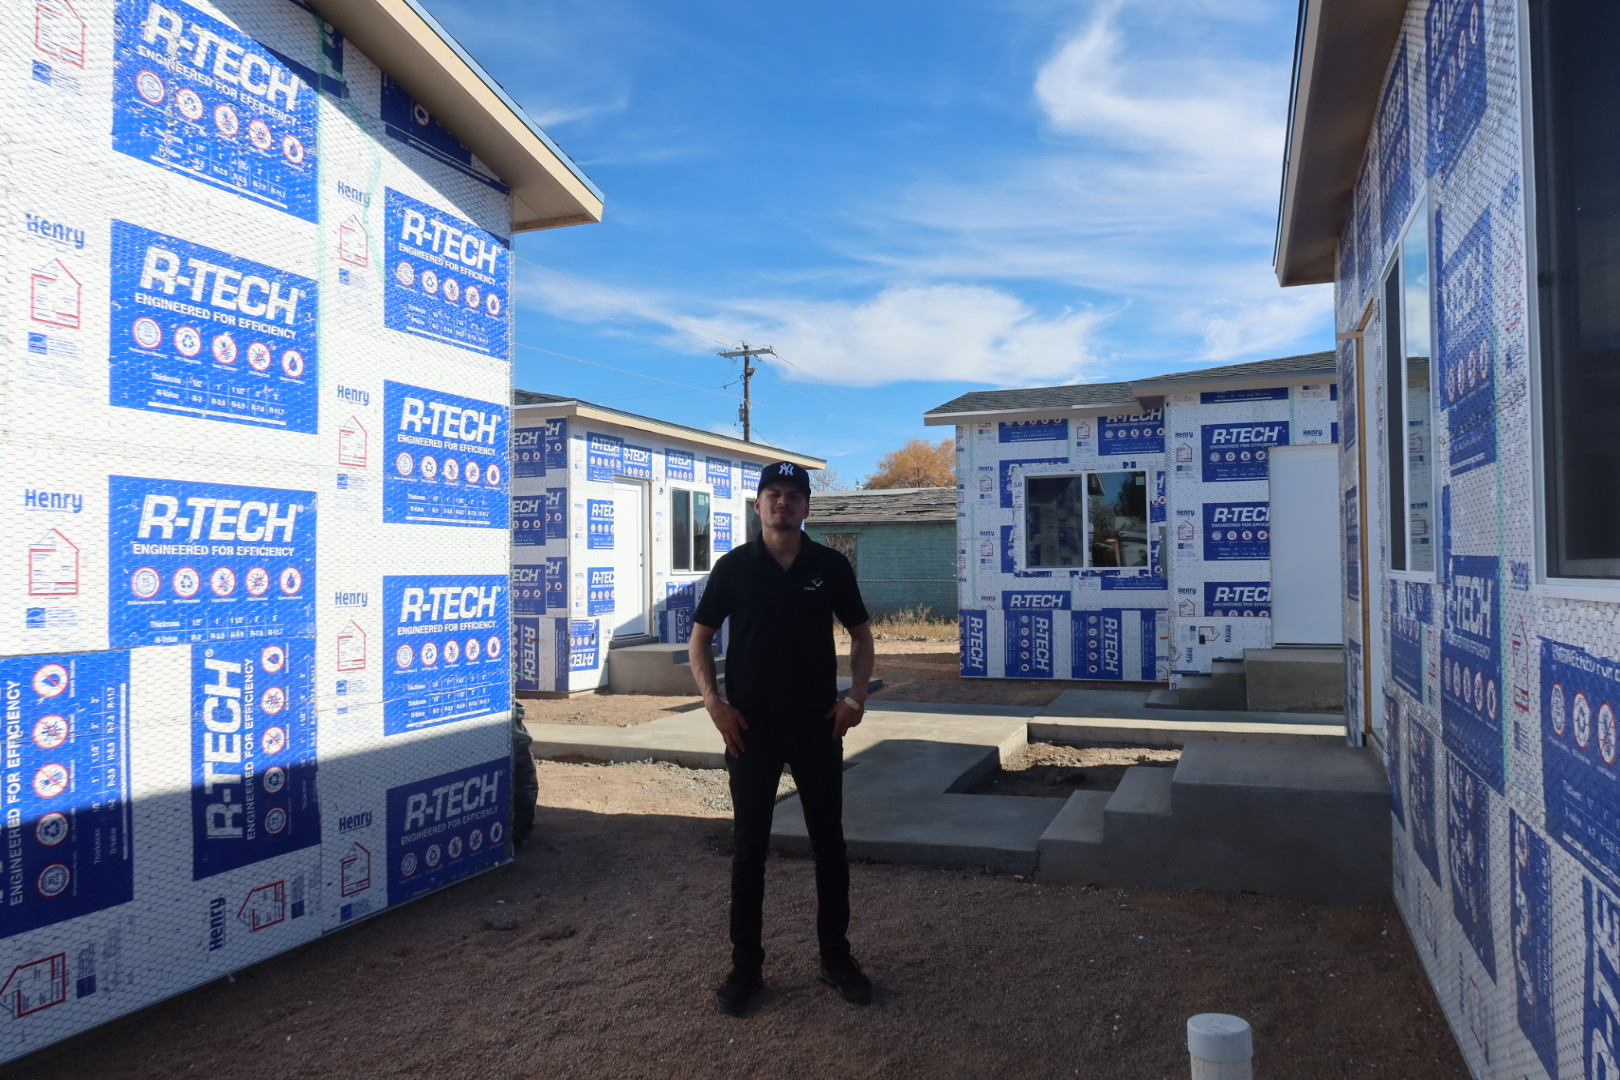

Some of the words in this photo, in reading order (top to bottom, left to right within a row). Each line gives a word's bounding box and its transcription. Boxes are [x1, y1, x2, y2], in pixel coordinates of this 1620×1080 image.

[215, 80, 239, 98] FOR
[239, 89, 299, 128] EFFICIENCY
[337, 180, 371, 208] Henry
[26, 213, 86, 250] Henry
[398, 242, 444, 267] ENGINEERED
[445, 259, 460, 271] FOR
[460, 265, 497, 286] EFFICIENCY
[135, 292, 211, 321] ENGINEERED
[213, 309, 237, 326] FOR
[239, 317, 297, 340] EFFICIENCY
[337, 385, 370, 406] Henry
[397, 434, 444, 449] ENGINEERED
[444, 442, 458, 451] FOR
[459, 443, 496, 457] EFFICIENCY
[1175, 431, 1194, 439] Henry
[1212, 427, 1279, 444] R-TECH
[24, 488, 83, 514] Henry
[1177, 509, 1195, 517] Henry
[133, 544, 210, 557] ENGINEERED
[212, 545, 235, 556] FOR
[237, 546, 295, 557] EFFICIENCY
[335, 591, 368, 608] Henry
[1010, 594, 1064, 608] R-TECH
[1178, 587, 1197, 595] Henry
[397, 623, 444, 636] ENGINEERED
[445, 623, 459, 632] FOR
[460, 621, 497, 631] EFFICIENCY
[970, 616, 984, 669] R-TECH
[1035, 617, 1050, 670] R-TECH
[1105, 617, 1119, 672] R-TECH
[524, 626, 536, 682] R-TECH
[244, 658, 254, 729] EFFICIENCY
[7, 680, 22, 768] EFFICIENCY
[244, 733, 254, 758] FOR
[7, 771, 21, 803] FOR
[245, 762, 256, 840] ENGINEERED
[403, 771, 499, 832] R-TECH
[339, 811, 373, 832] Henry
[401, 823, 447, 846] ENGINEERED
[448, 817, 462, 829] FOR
[463, 806, 499, 824] EFFICIENCY
[8, 808, 24, 906] ENGINEERED
[209, 897, 228, 953] Henry
